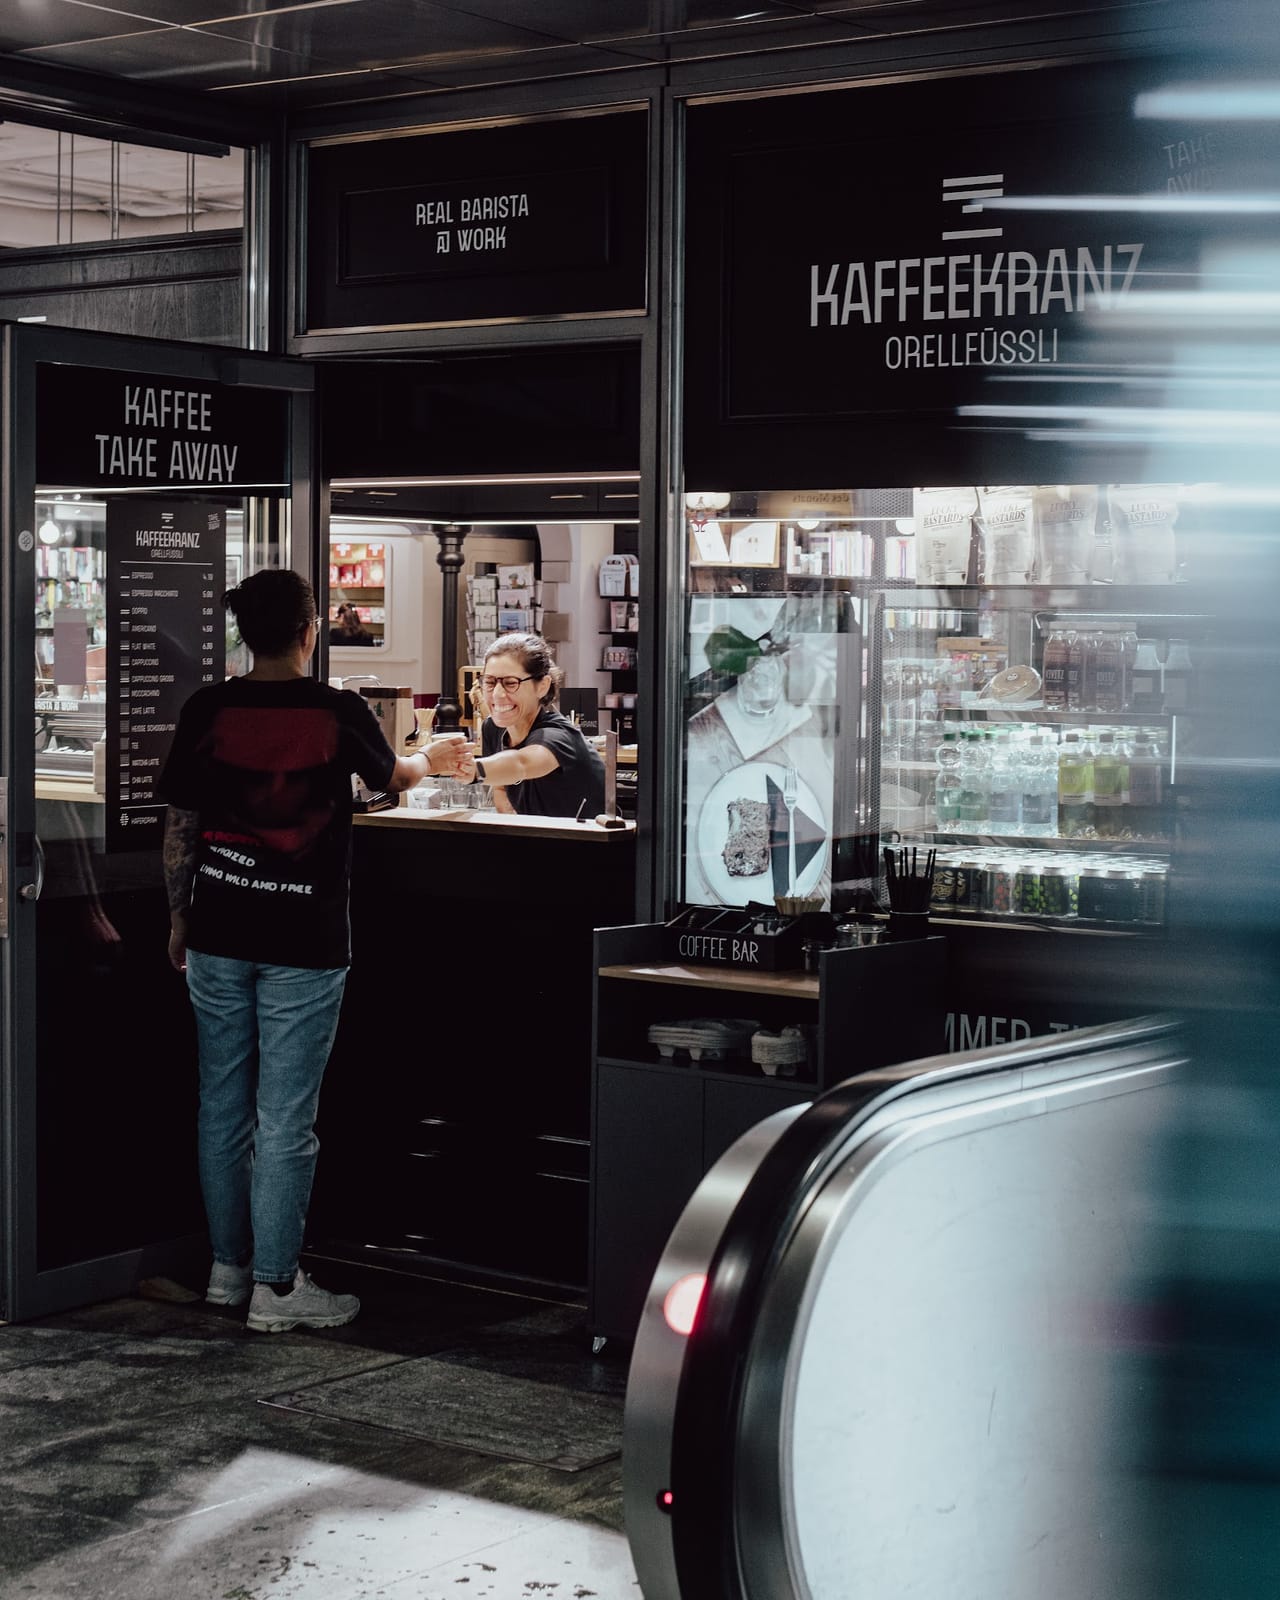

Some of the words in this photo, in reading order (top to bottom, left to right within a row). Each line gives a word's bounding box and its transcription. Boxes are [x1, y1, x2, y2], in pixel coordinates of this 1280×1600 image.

[416, 201, 454, 225] REAL
[461, 194, 529, 221] BARISTA
[457, 226, 506, 252] WORK
[810, 243, 1144, 327] KAFFEEKRANZ
[125, 385, 212, 431] KAFFEE
[95, 434, 157, 478] TAKE
[169, 440, 239, 483] AWAY
[136, 530, 200, 548] KAFFEEKRANZ
[200, 863, 224, 880] LIVING
[225, 872, 249, 887] WILD
[251, 880, 278, 892] AND
[280, 884, 313, 895] FREE
[679, 934, 728, 960] COFFEE
[732, 940, 759, 964] BAR
